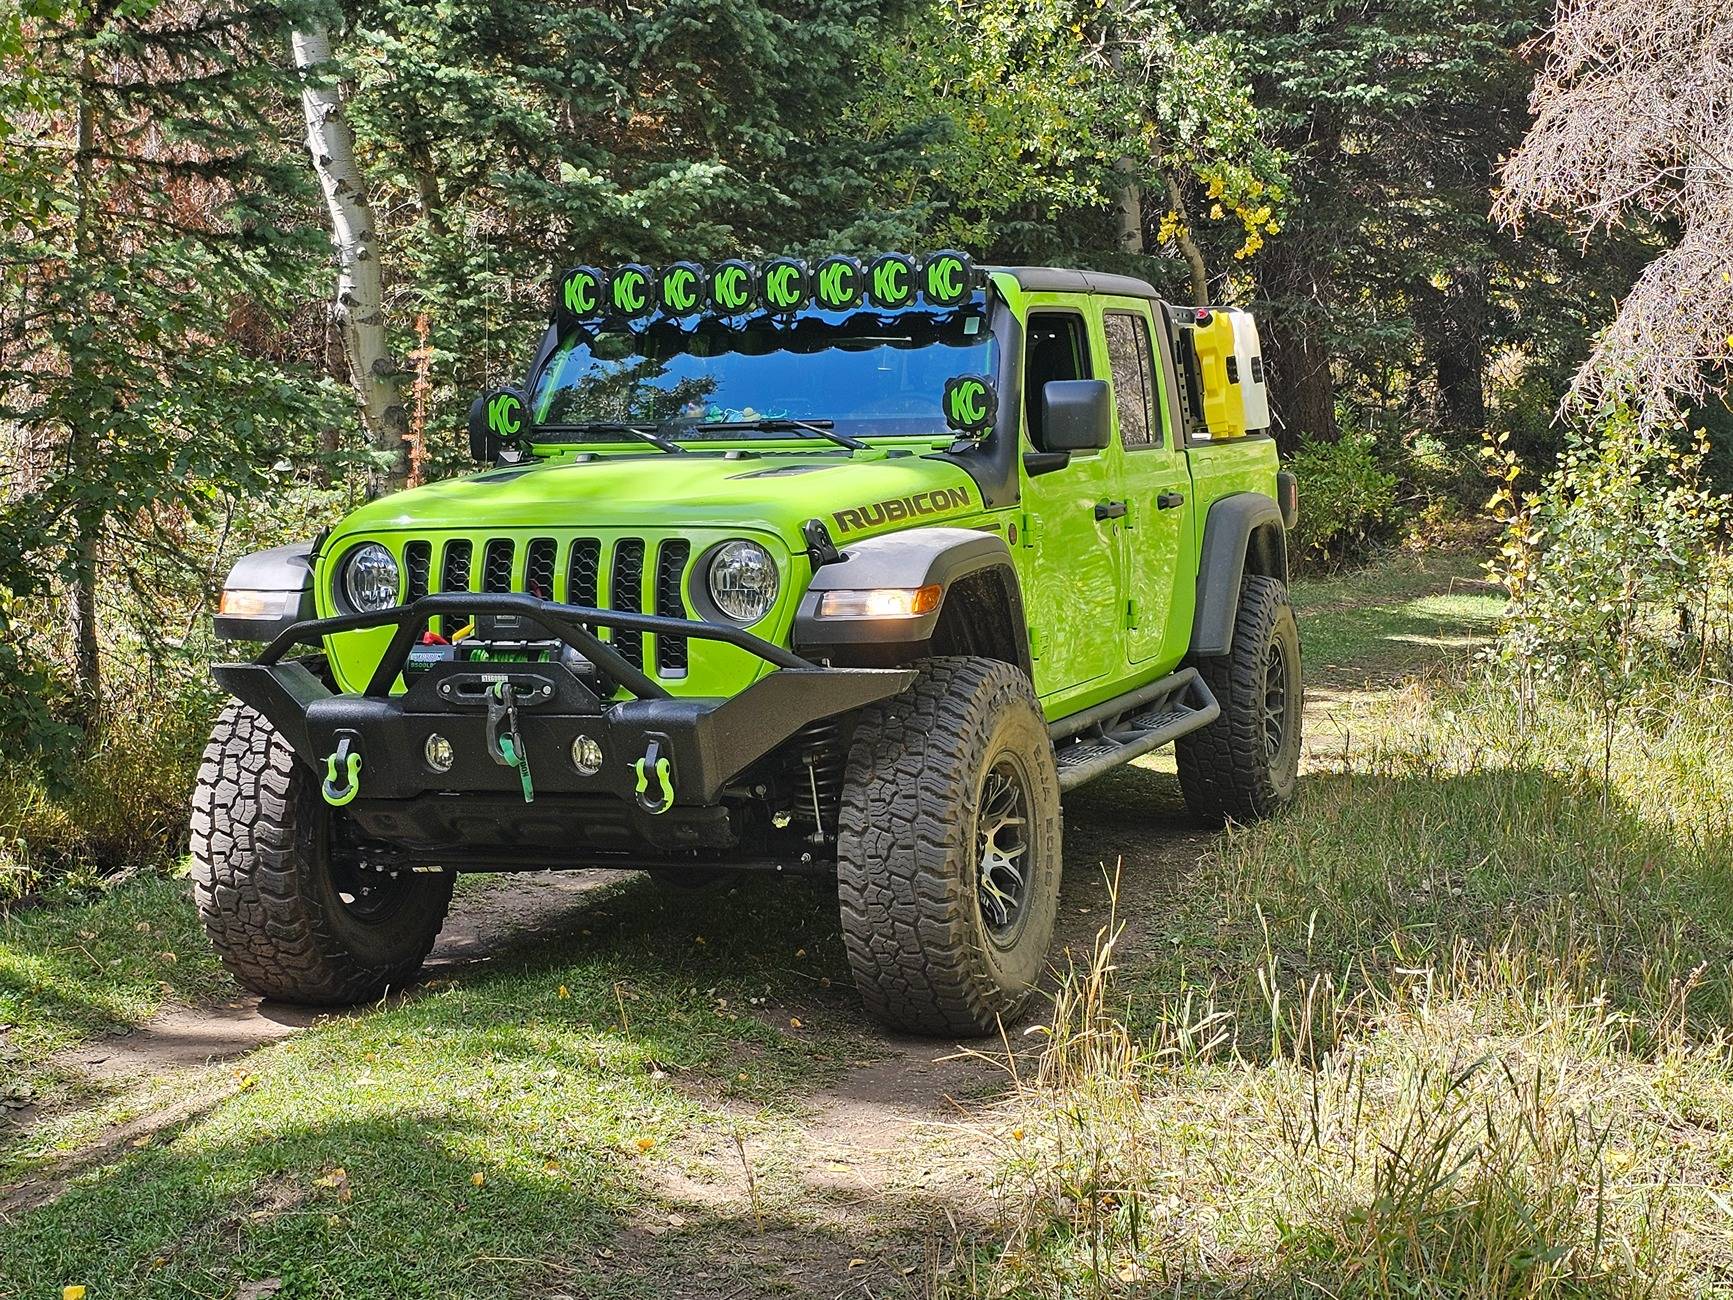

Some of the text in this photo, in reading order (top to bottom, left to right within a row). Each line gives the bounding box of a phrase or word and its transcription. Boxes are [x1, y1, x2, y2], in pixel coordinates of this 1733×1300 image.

[564, 272, 595, 313] KC
[613, 271, 645, 312] KC
[663, 269, 695, 310] KC
[715, 267, 748, 308] KC
[767, 265, 800, 307] KC
[819, 263, 853, 305] KC
[873, 260, 908, 302] KC
[928, 258, 963, 301] KC
[488, 394, 521, 436] KC
[950, 380, 987, 425] KC
[832, 486, 971, 533] RUBICON
